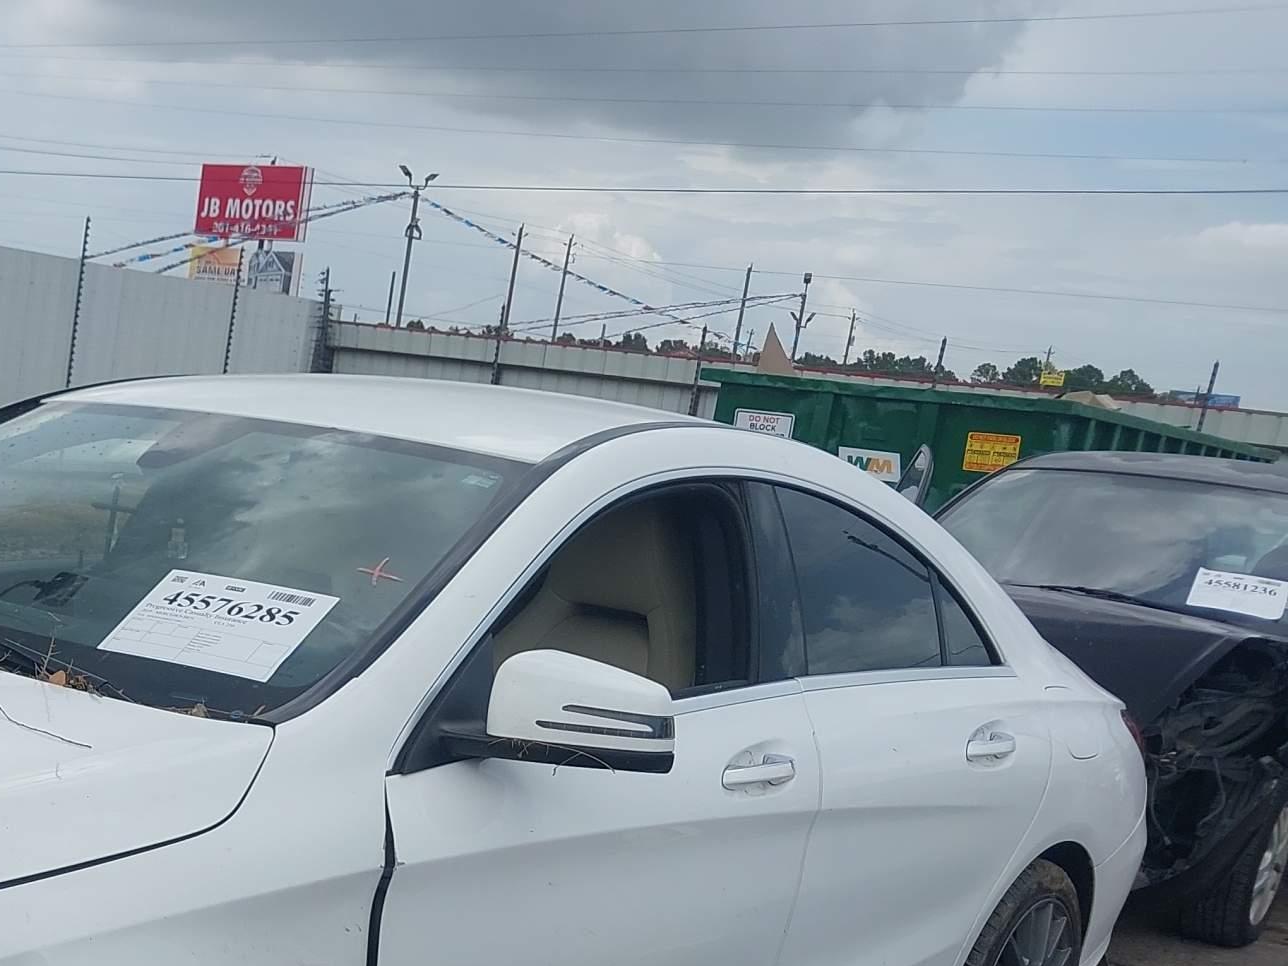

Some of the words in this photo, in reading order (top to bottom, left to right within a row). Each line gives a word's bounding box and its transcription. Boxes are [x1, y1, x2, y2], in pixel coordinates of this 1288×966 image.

[200, 197, 220, 218] JB
[225, 198, 295, 221] MOTORS
[749, 422, 777, 432] BLOCK
[763, 416, 781, 424] NOT
[1204, 579, 1277, 597] 45581236
[163, 590, 301, 626] 45576285
